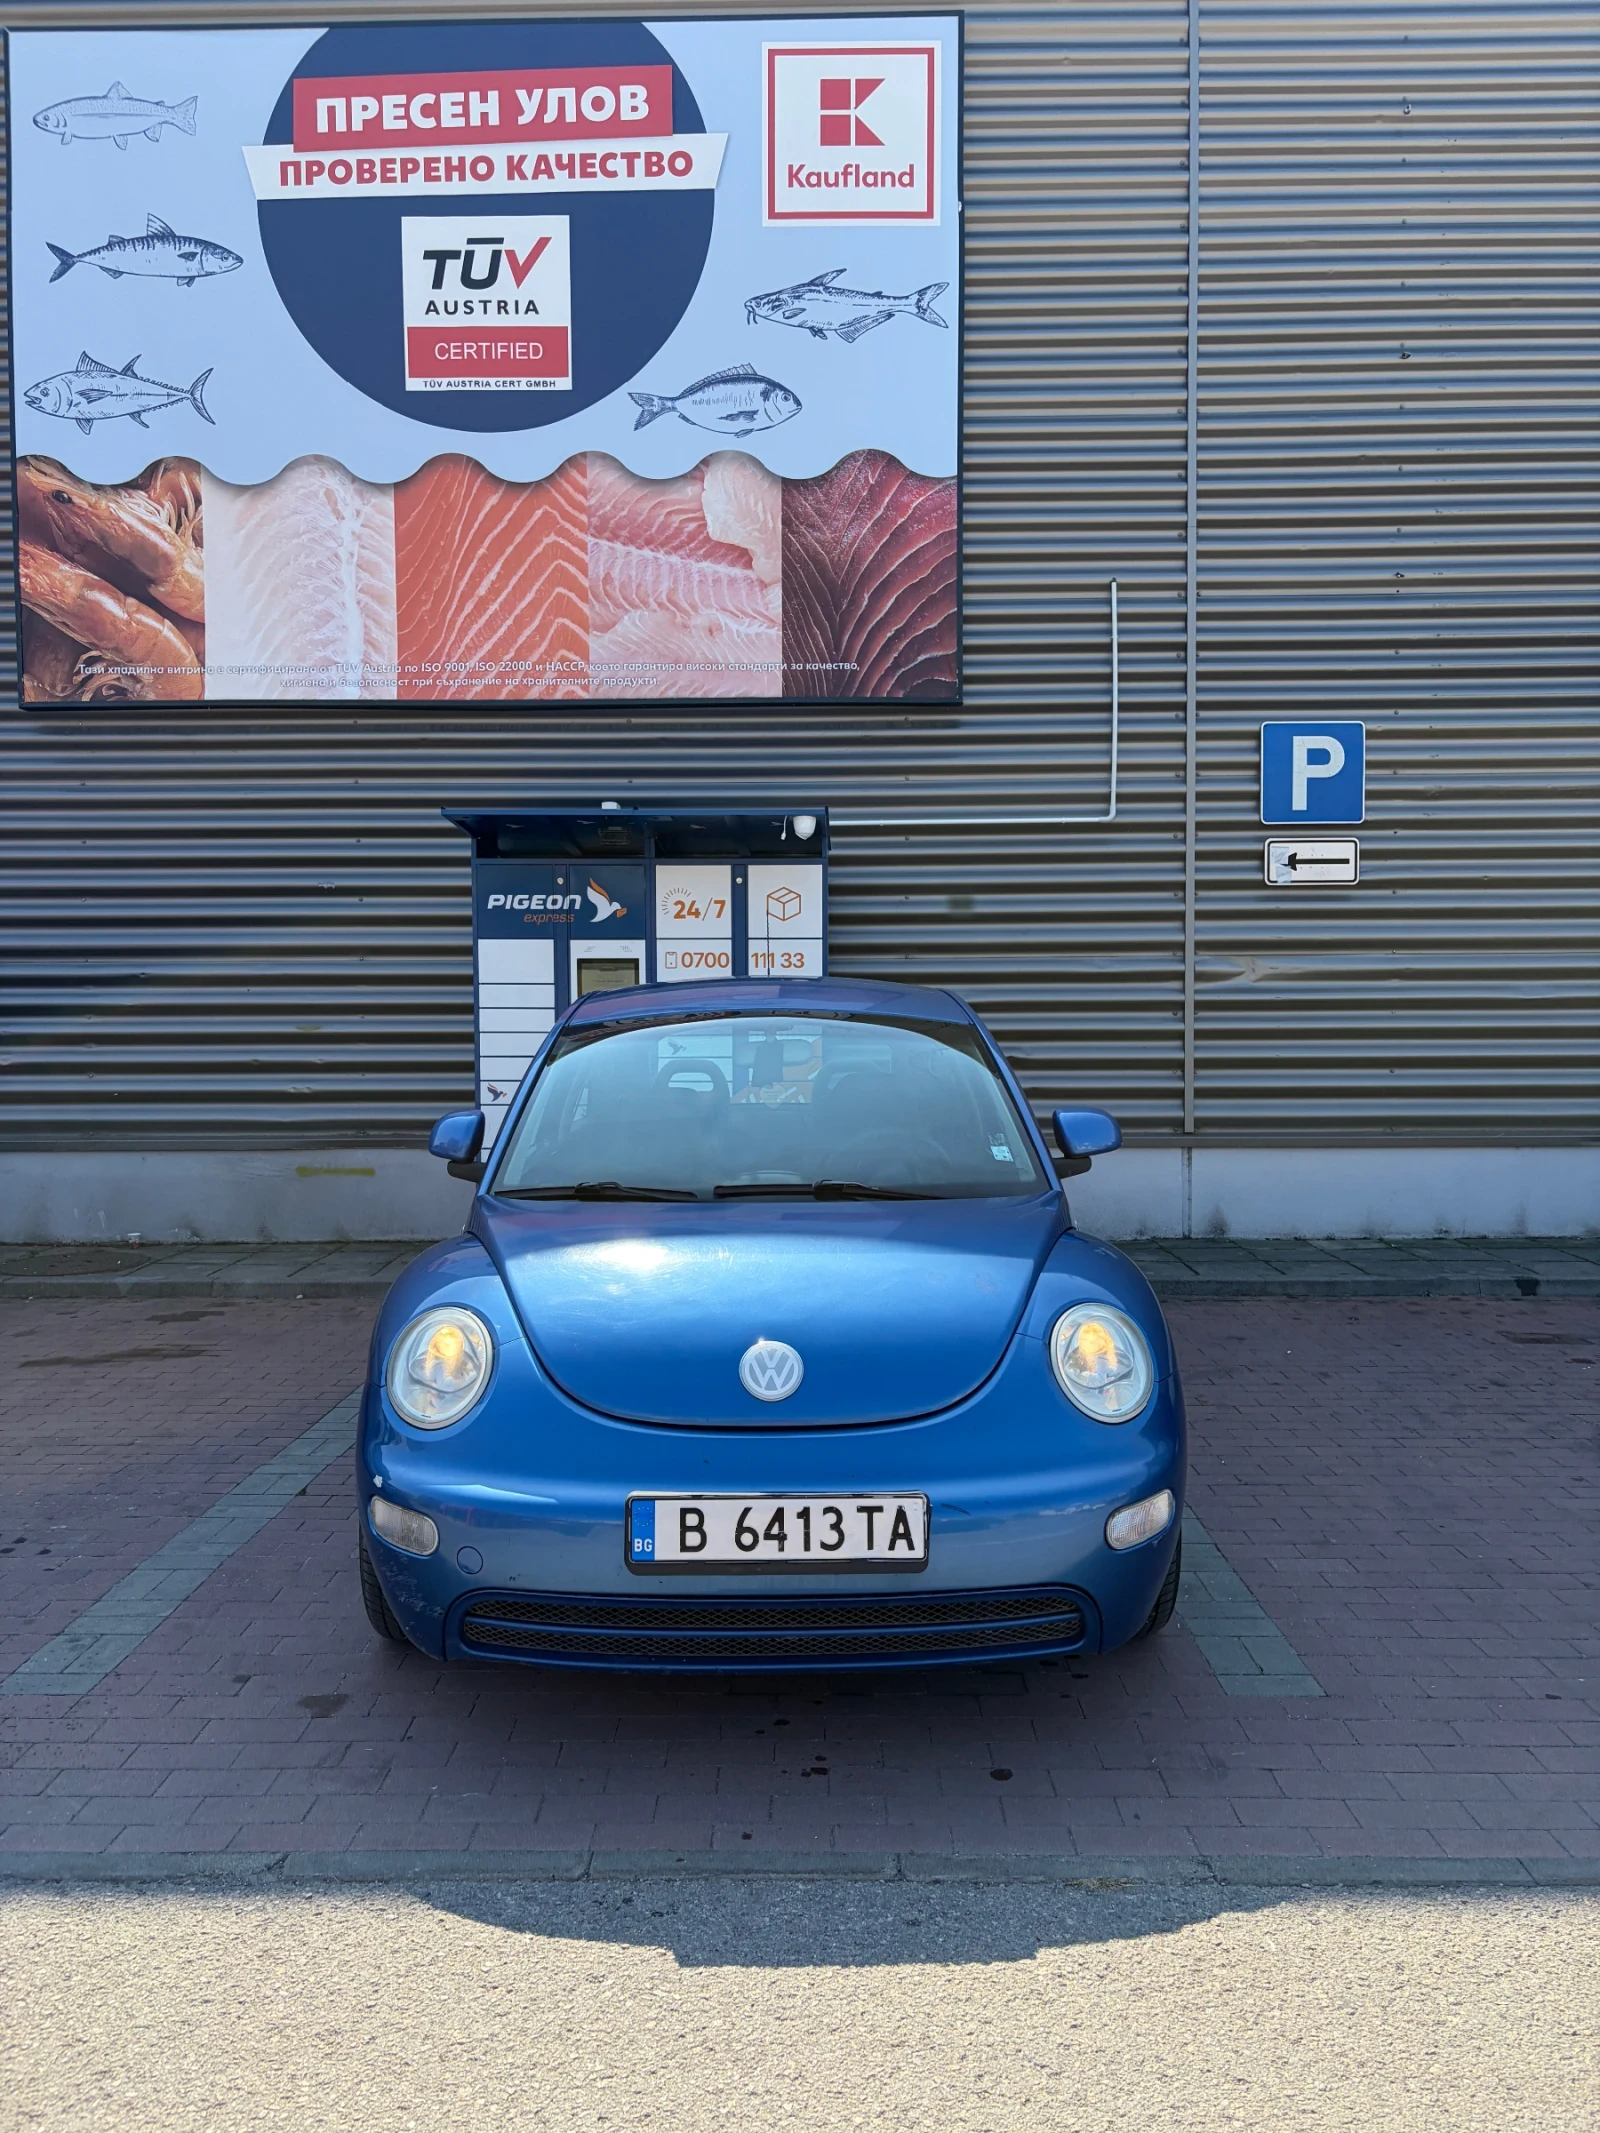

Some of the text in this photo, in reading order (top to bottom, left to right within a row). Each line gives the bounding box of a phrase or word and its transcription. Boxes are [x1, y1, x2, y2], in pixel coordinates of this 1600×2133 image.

[316, 85, 650, 133] ПРЕСЕН УЛОВ
[279, 150, 694, 187] ПРОВЕРЕНО КАЧЕСТВО
[787, 163, 915, 188] Kaufland
[424, 299, 540, 315] AUSTRIA
[434, 342, 543, 360] CERTIFIED
[423, 379, 556, 388] TÜV AUSTRIA CERT GMBH
[78, 664, 105, 675] Тази
[107, 665, 164, 676] хладилна
[167, 666, 214, 675] витрина
[216, 666, 224, 674] е
[226, 664, 316, 676] сертифицирана
[363, 662, 401, 673] Austria
[404, 664, 418, 672] по
[421, 662, 441, 672] ISO
[444, 662, 473, 673] 9001,
[475, 661, 496, 671] ISO
[498, 661, 532, 671] 22000
[589, 663, 621, 671] което
[623, 663, 683, 672] гарантира
[686, 663, 725, 671] високи
[728, 663, 787, 672] стандарти
[806, 662, 860, 671] качество,
[280, 679, 326, 688] хигиена
[339, 678, 409, 687] безопасност
[412, 679, 433, 688] при
[436, 677, 502, 688] съхранение
[522, 677, 600, 687] хранителните
[603, 677, 660, 687] продукти.
[1292, 735, 1345, 811] P
[487, 894, 582, 910] PIGEON
[673, 897, 726, 921] 24/7
[523, 913, 575, 925] express
[680, 952, 805, 969] 0700 111 33
[745, 1347, 798, 1392] VW
[633, 1538, 653, 1553] BG
[679, 1506, 707, 1553] B
